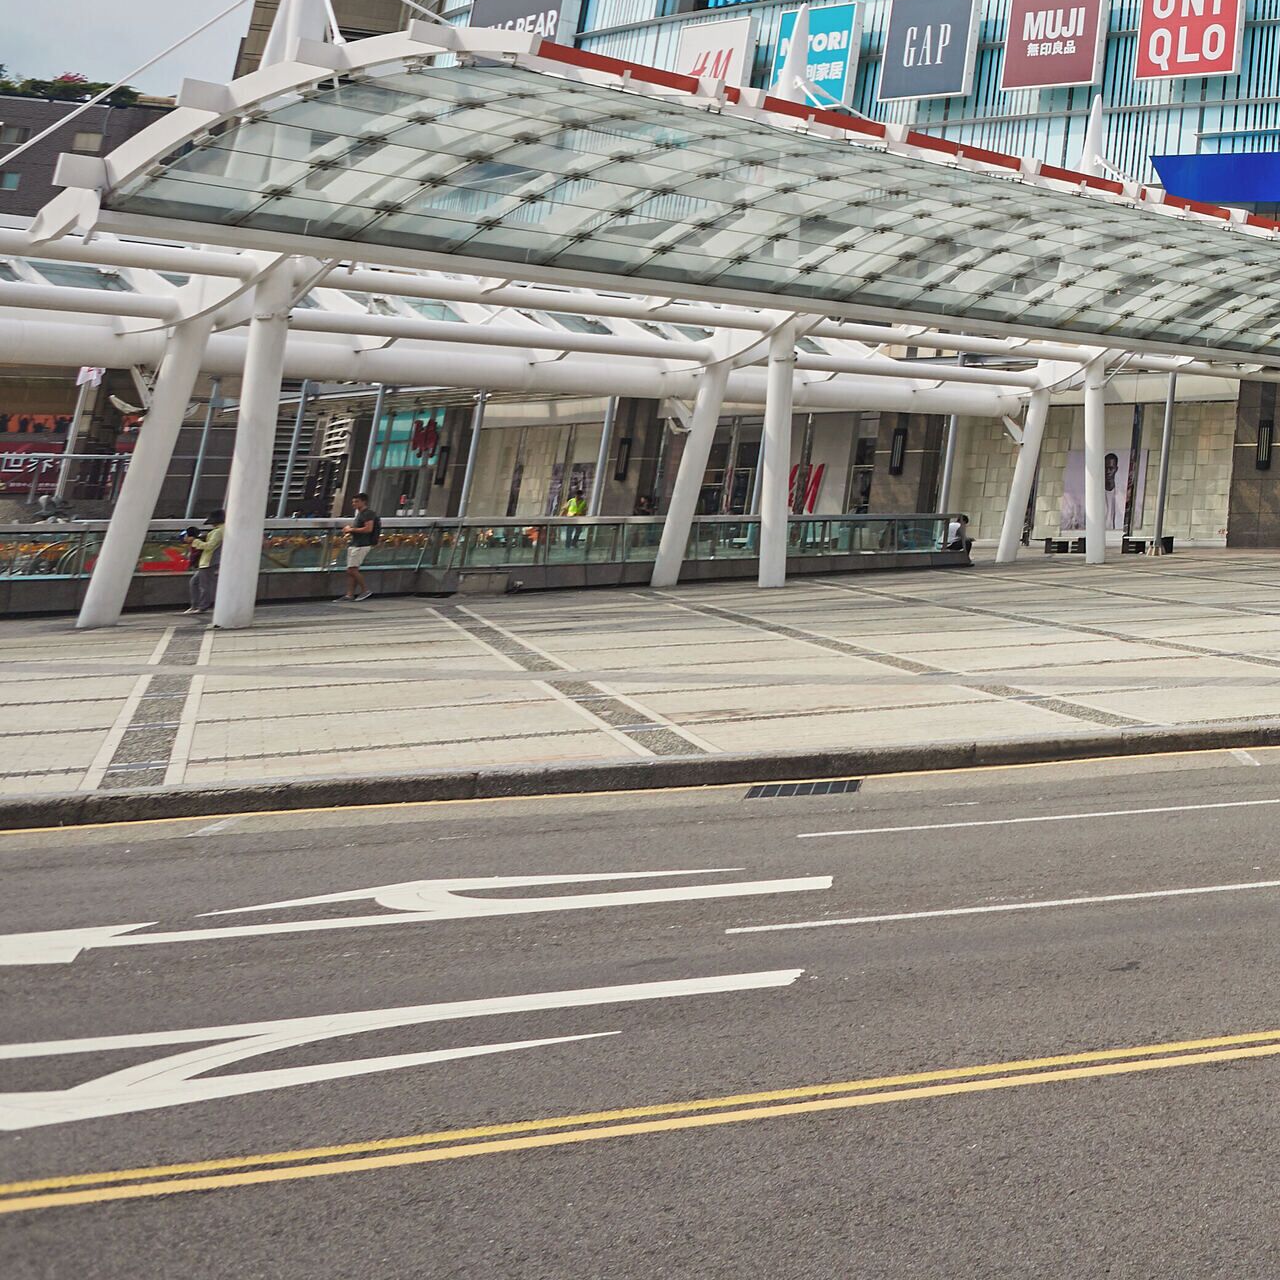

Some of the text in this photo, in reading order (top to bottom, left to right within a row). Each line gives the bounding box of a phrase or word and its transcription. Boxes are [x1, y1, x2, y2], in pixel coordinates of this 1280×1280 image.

[1022, 7, 1086, 41] MUJI
[780, 30, 849, 56] NTORI
[902, 23, 951, 68] GAP
[1026, 42, 1076, 57] 無印良品
[1148, 23, 1226, 71] QLO
